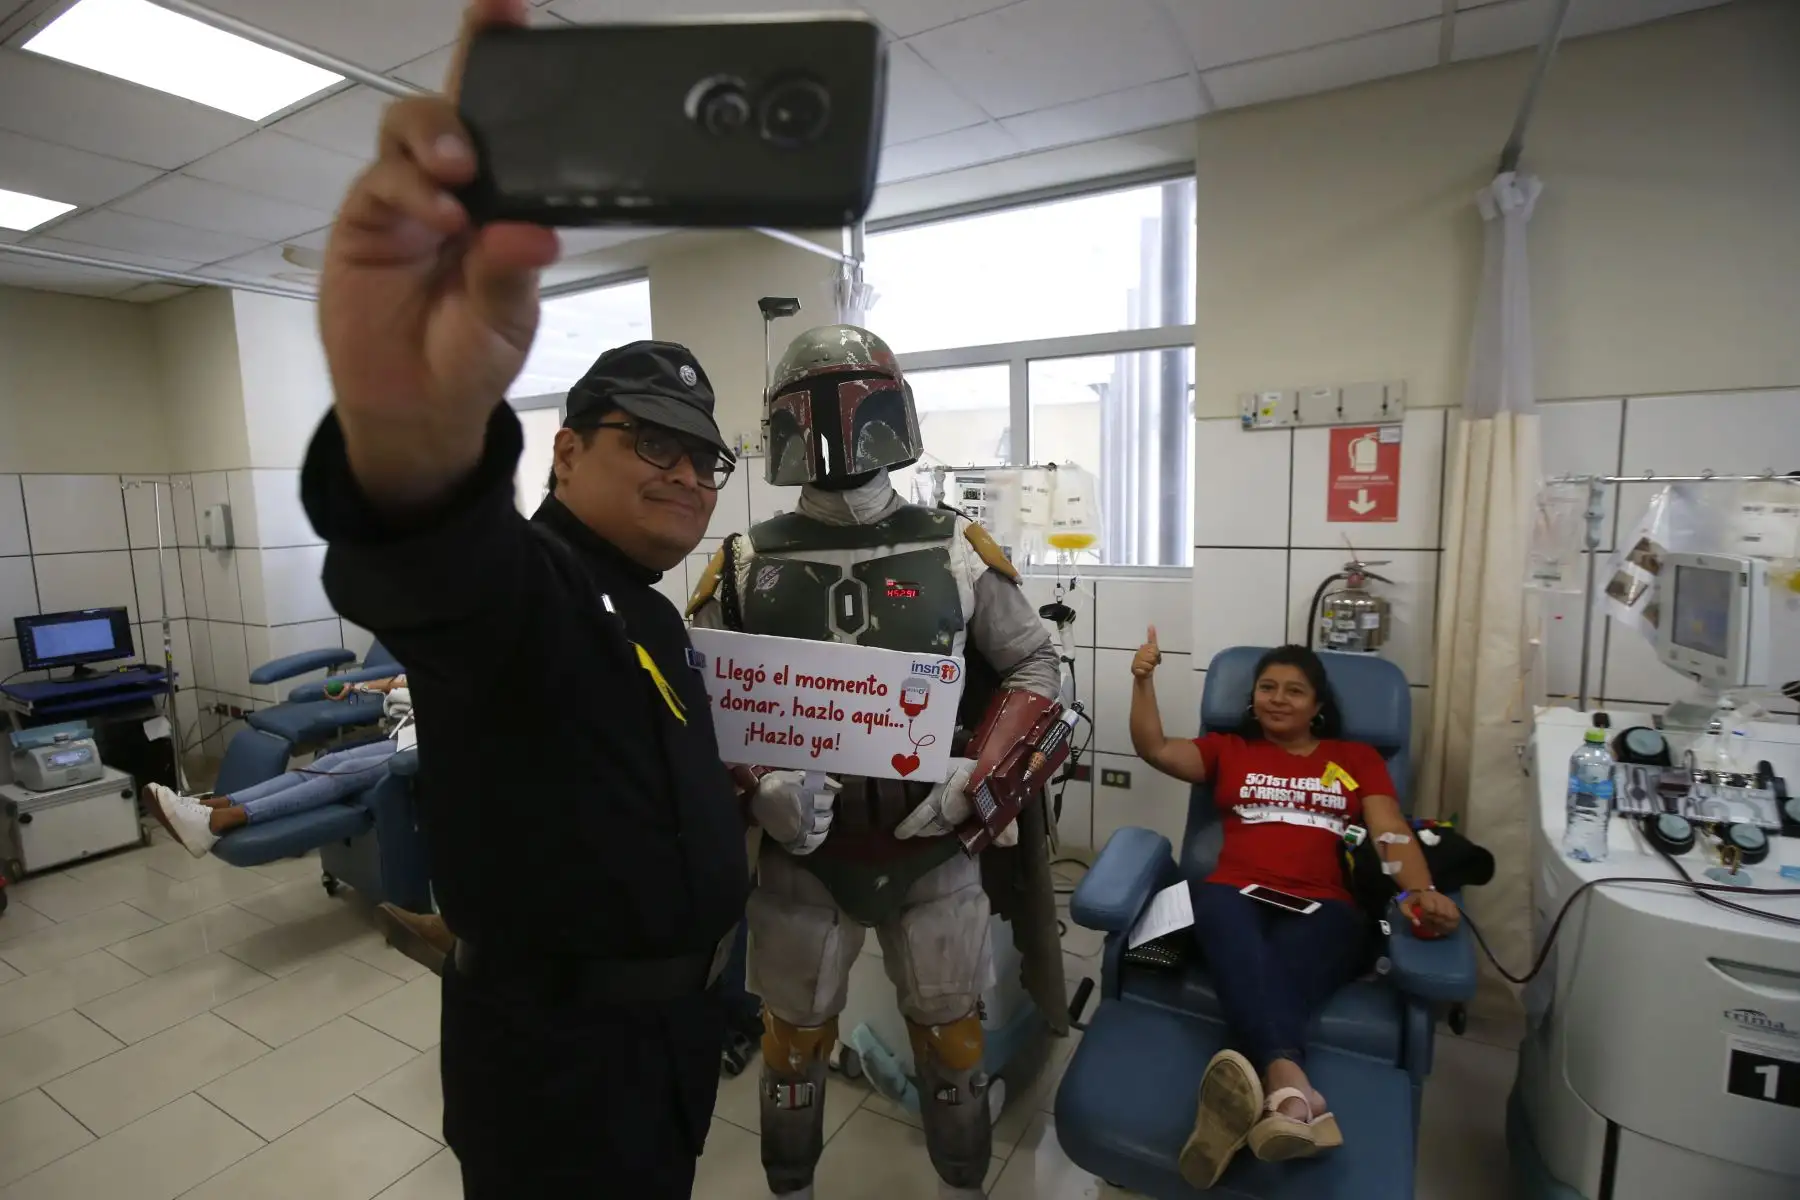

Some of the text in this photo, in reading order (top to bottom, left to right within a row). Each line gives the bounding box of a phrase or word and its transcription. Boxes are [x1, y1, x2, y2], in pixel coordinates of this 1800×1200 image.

[715, 656, 888, 697] Llegó el momento
[911, 660, 940, 675] insn
[720, 689, 785, 717] donar,
[792, 696, 845, 721] hazlo
[851, 708, 905, 734] aquí...
[744, 722, 841, 758] ¡Hazlo ya!
[1240, 786, 1347, 810] GARRISON PERU
[1245, 773, 1289, 787] 501ST
[1754, 1064, 1780, 1100] 1
